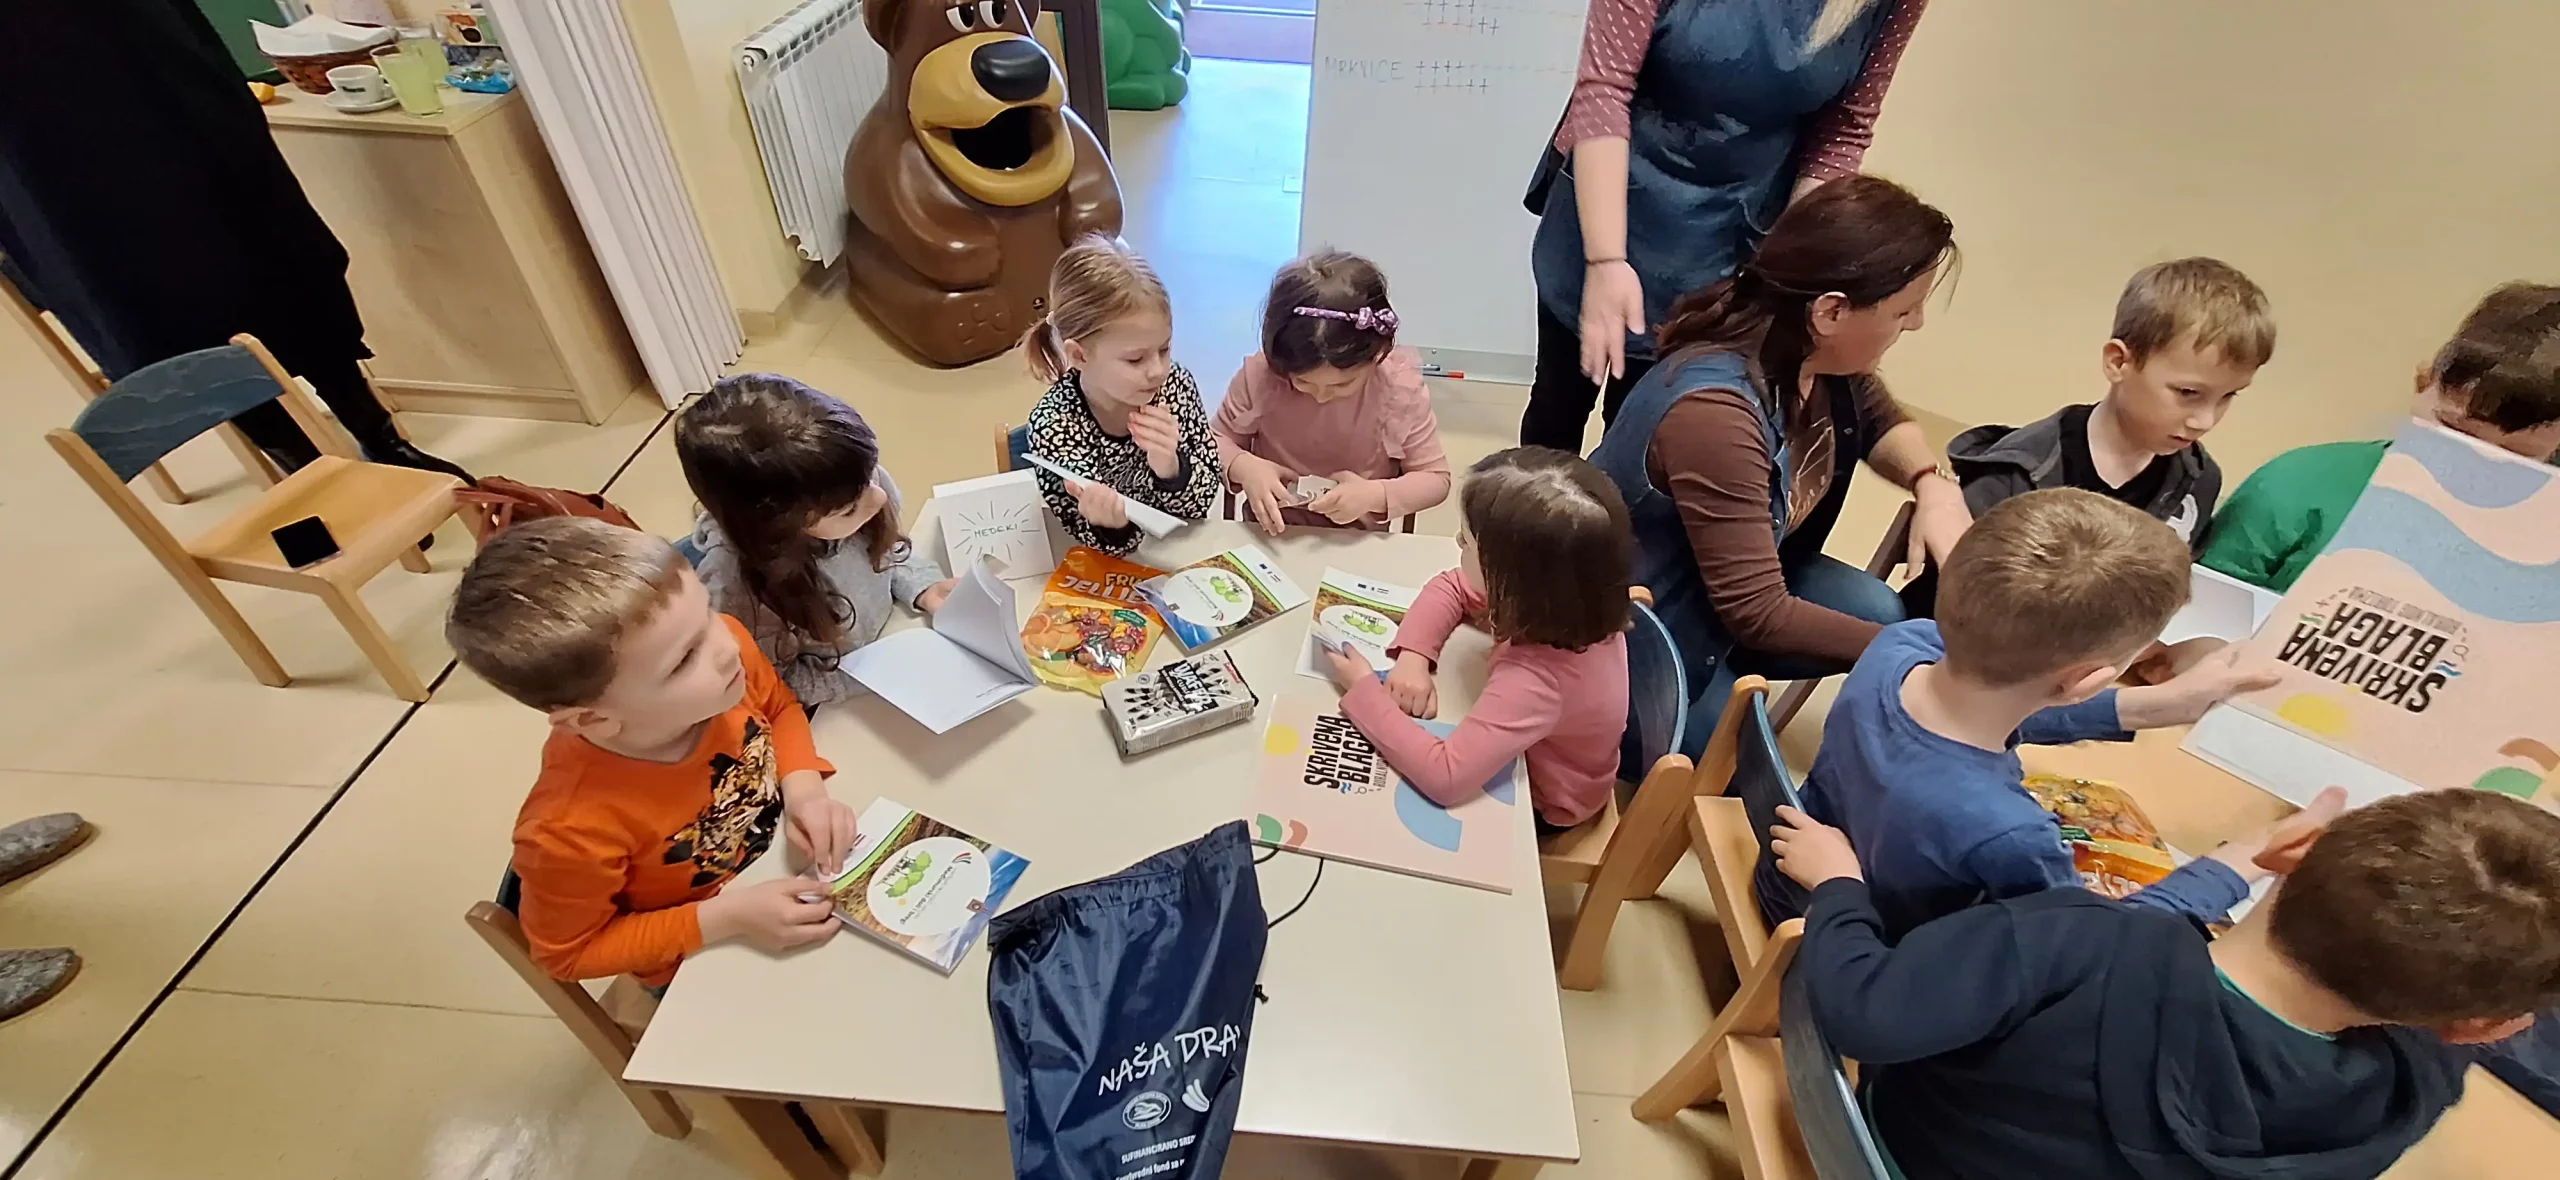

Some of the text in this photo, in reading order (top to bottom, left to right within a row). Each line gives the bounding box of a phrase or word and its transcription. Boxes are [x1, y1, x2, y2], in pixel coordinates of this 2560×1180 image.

[1057, 575, 1146, 603] JELLIE
[2276, 622, 2447, 713] SKRIVENA
[2322, 602, 2448, 672] BLAGA
[1303, 715, 1352, 789] SKRIVENA
[1098, 1041, 1171, 1096] NAŠA
